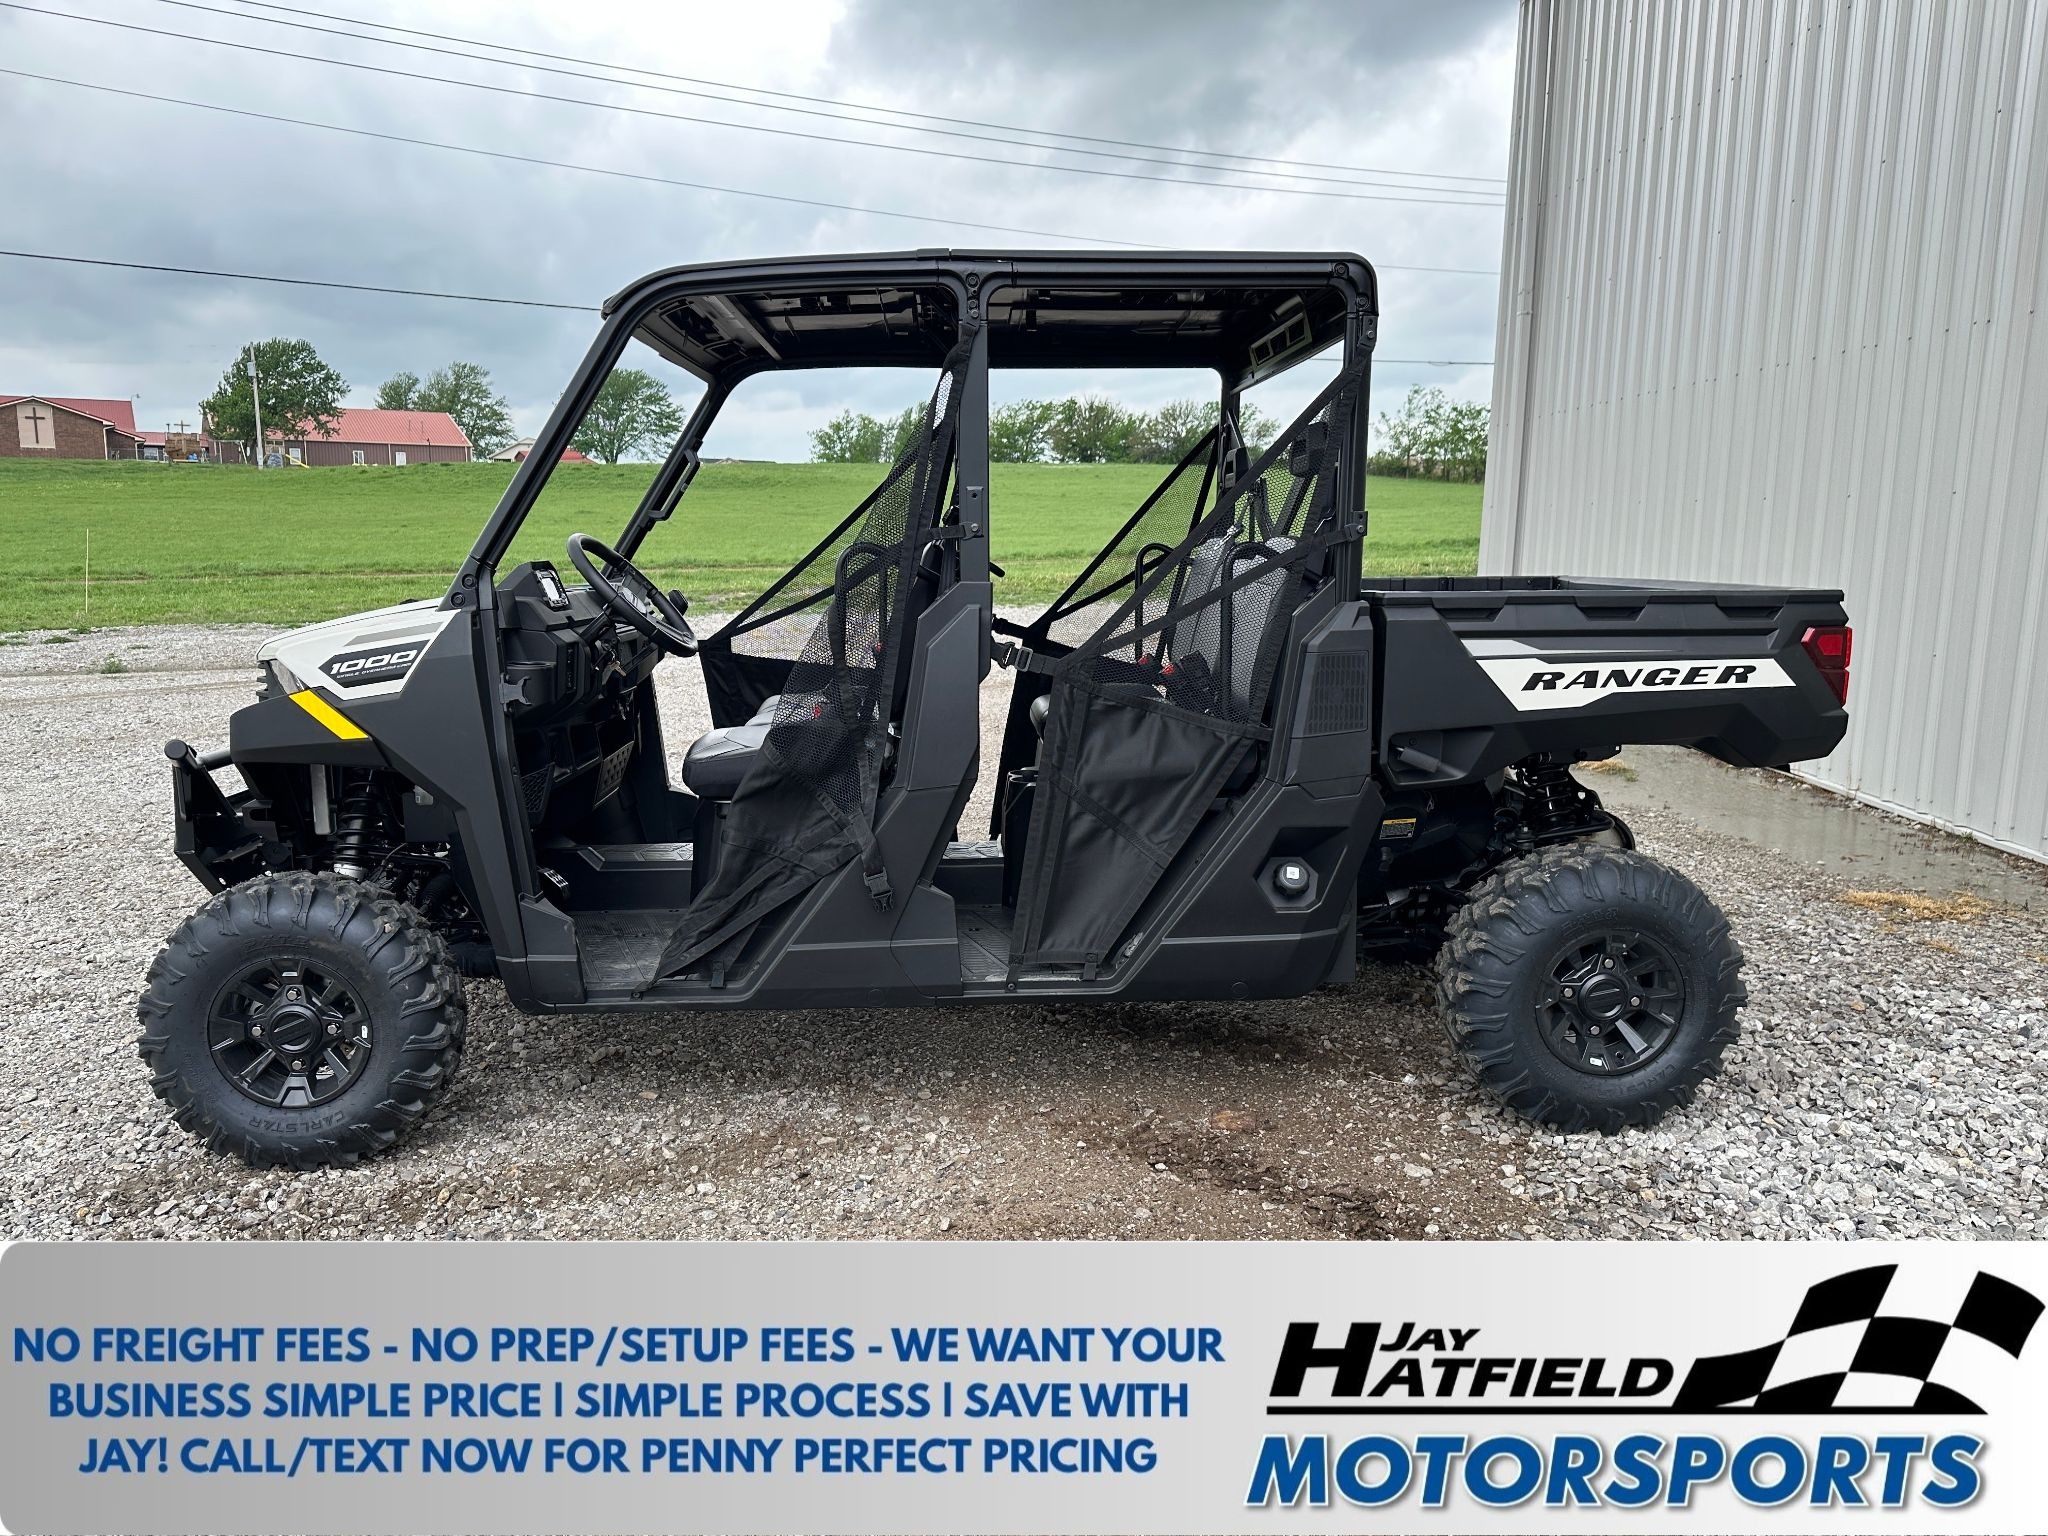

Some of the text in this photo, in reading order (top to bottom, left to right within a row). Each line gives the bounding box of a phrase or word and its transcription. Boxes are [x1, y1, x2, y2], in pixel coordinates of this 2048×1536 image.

[330, 650, 418, 674] 1000
[1521, 665, 1757, 691] RANGER
[248, 1110, 344, 1133] CARLSTAR
